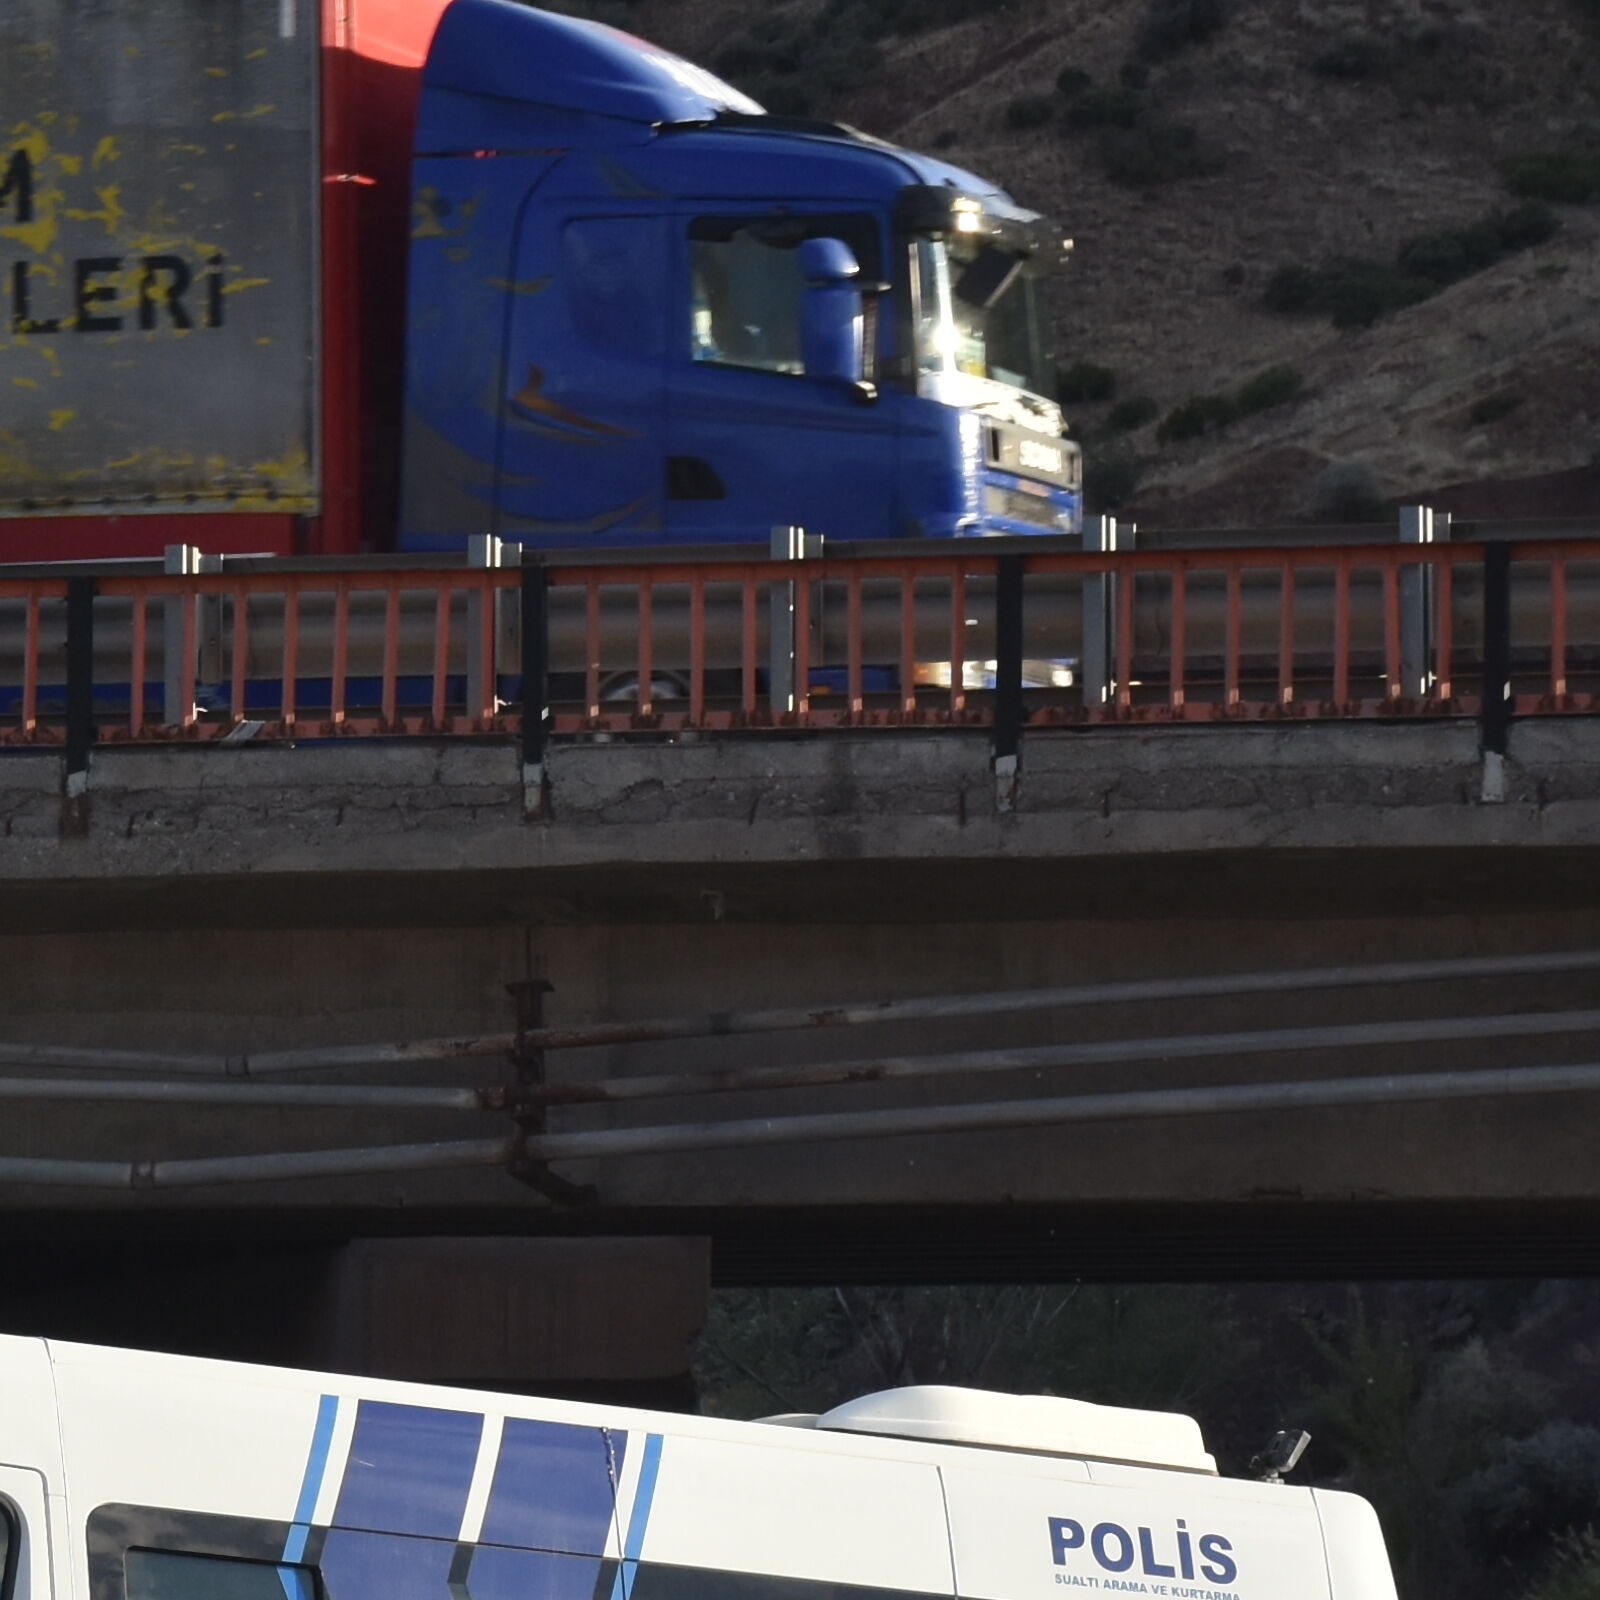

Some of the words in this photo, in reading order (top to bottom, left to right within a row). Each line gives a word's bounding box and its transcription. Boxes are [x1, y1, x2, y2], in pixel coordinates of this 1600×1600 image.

[1047, 1516, 1238, 1585] POLİS
[1054, 1573, 1099, 1588] SUALTI
[1103, 1579, 1148, 1594] ARAMA
[1150, 1584, 1168, 1596] VE
